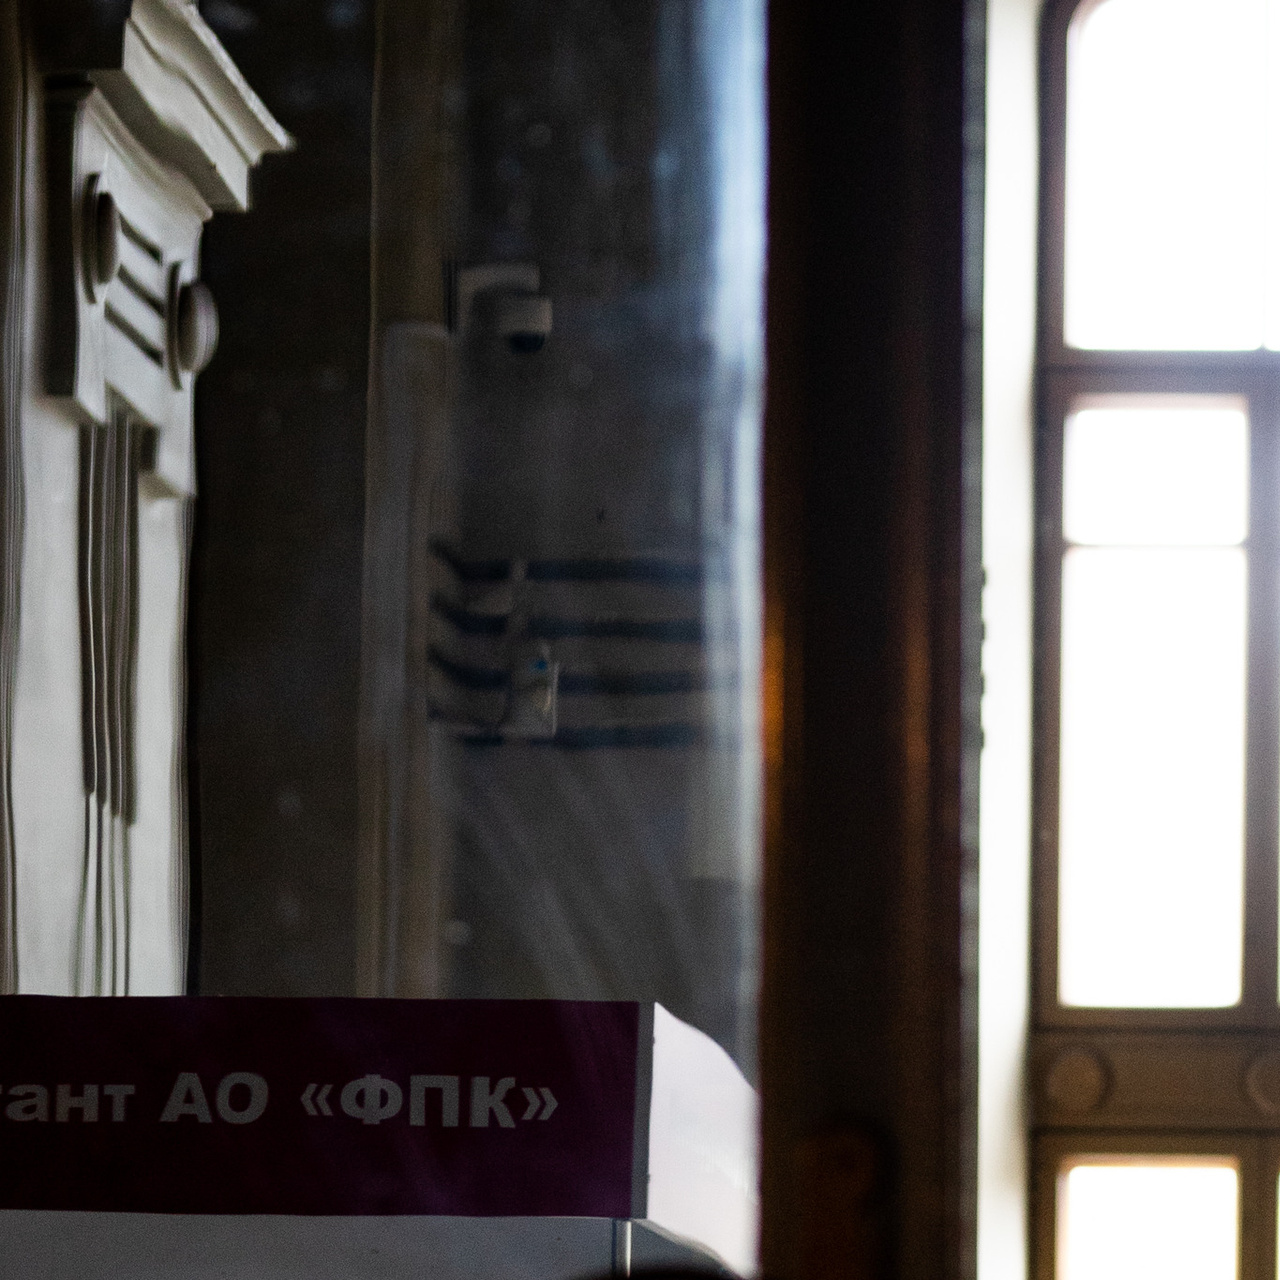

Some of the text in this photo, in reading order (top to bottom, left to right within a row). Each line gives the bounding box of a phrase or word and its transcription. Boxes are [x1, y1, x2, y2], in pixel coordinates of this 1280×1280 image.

[0, 1072, 559, 1129] ант АО «ФПК»
